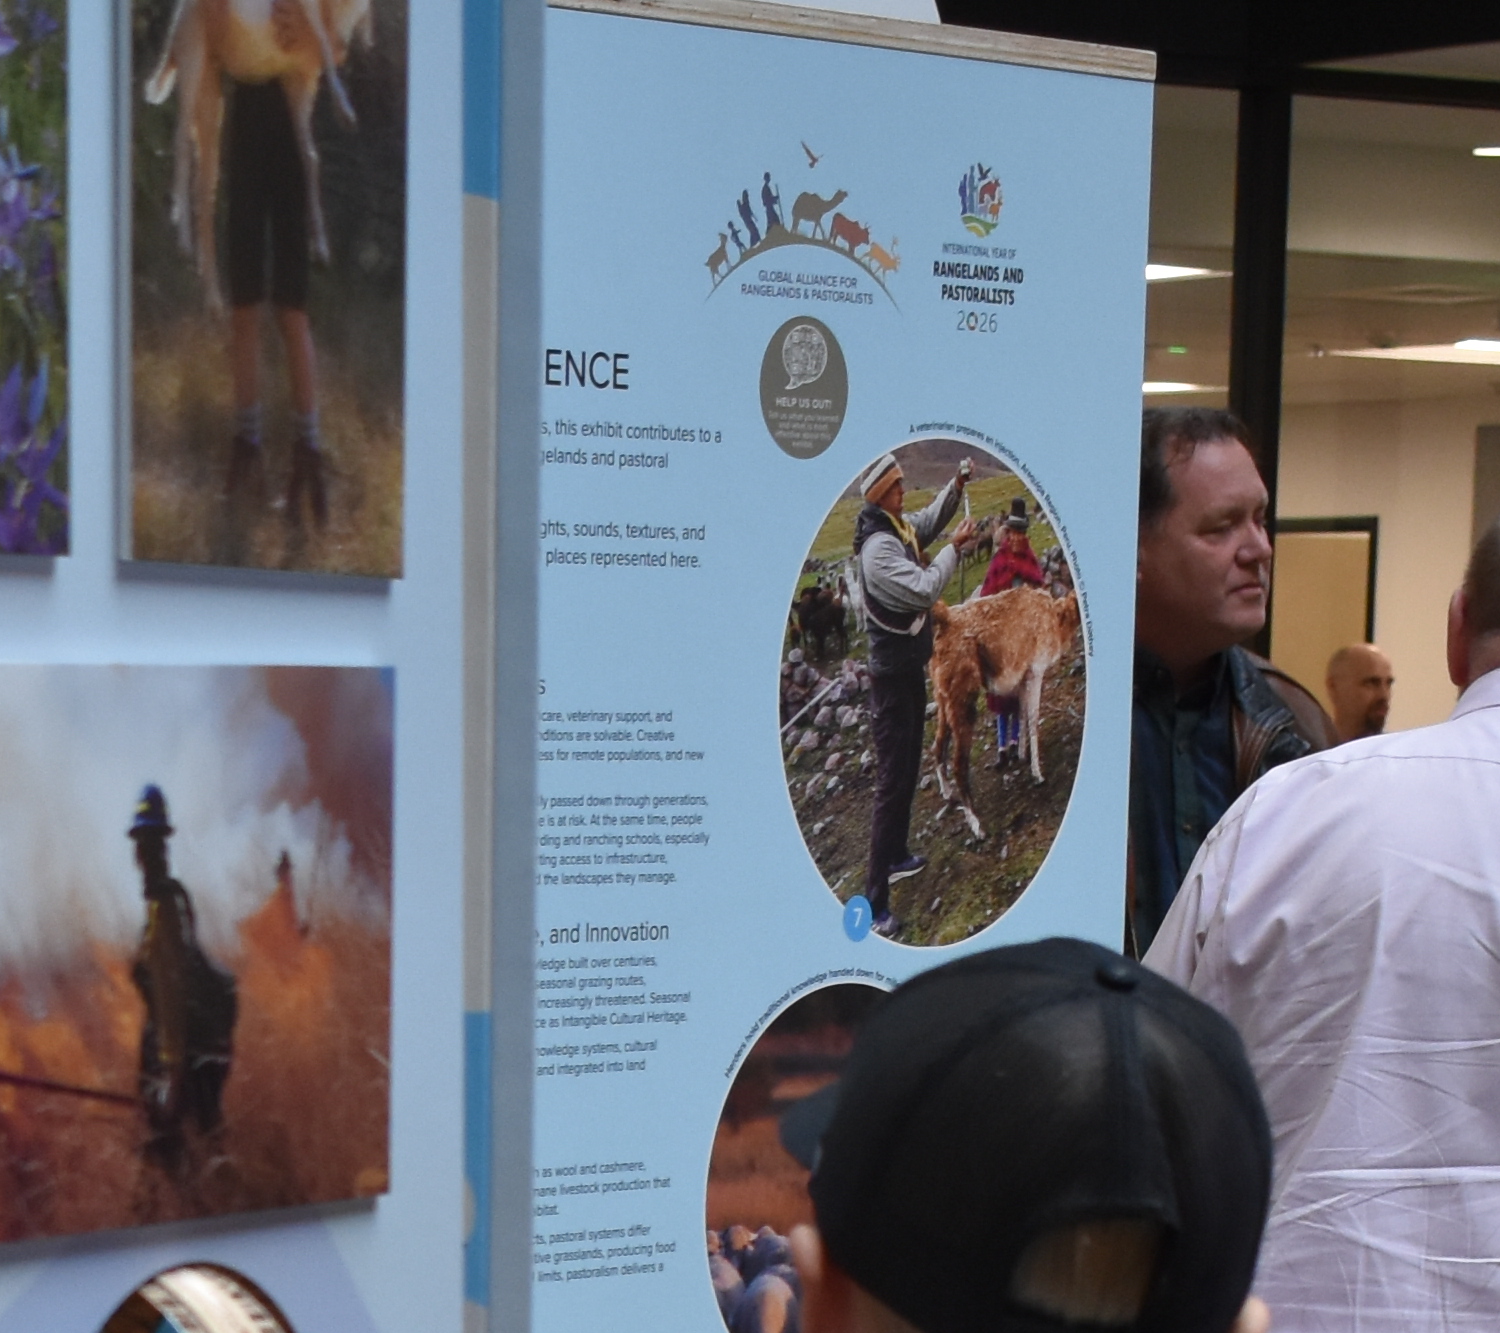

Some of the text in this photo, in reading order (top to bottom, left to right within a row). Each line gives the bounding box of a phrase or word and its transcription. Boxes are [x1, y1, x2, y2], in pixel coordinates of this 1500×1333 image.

[942, 243, 1016, 259] INTERNATIONAL YEAR OF
[758, 270, 857, 288] GLOBAL ALLIANCE FOR
[933, 261, 1023, 284] RANGELANDS AND
[741, 283, 873, 305] RANGELANDS & PASTORALISTS
[941, 284, 1014, 305] PASTORALISTS
[957, 310, 998, 333] 2026
[545, 348, 629, 390] ENCE
[776, 397, 832, 409] HELP US OUT!
[555, 418, 577, 435] this
[582, 421, 623, 438] exhibit
[626, 424, 695, 442] contributes
[700, 428, 711, 442] to
[715, 431, 722, 443] a
[909, 424, 914, 434] A
[591, 450, 668, 469] and pastoral
[573, 522, 705, 541] sounds, textures, and
[546, 548, 701, 568] places represented here.
[567, 710, 672, 724] veterinary support, and
[576, 731, 590, 741] are
[637, 729, 674, 741] Creative
[557, 749, 569, 761] for
[572, 750, 605, 761] remote
[665, 750, 683, 761] and
[685, 751, 703, 760] new
[551, 795, 584, 808] passed
[587, 795, 612, 807] down
[614, 795, 650, 809] through
[548, 815, 554, 826] is
[557, 816, 566, 826] at
[590, 814, 600, 825] At
[602, 814, 617, 825] the
[620, 816, 644, 825] same
[671, 814, 702, 826] people
[563, 834, 581, 846] and
[584, 833, 623, 847] ranching
[665, 832, 709, 846] especially
[559, 855, 591, 865] access
[594, 854, 602, 864] to
[544, 874, 558, 884] the
[562, 873, 614, 886] landscapes
[616, 872, 636, 885] they
[853, 908, 862, 928] 7
[550, 923, 580, 944] and
[586, 921, 669, 942] Innovation
[569, 957, 588, 969] built
[591, 959, 611, 968] over
[829, 967, 854, 979] handed
[855, 968, 874, 978] down
[578, 976, 612, 991] grazing
[650, 992, 691, 1004] Seasonal
[549, 1018, 559, 1028] as
[562, 1014, 607, 1029] Intangible
[610, 1012, 644, 1025] Cultural
[624, 1040, 657, 1052] cultural
[536, 1059, 646, 1077] and integrated into land
[542, 1168, 552, 1177] as
[555, 1165, 577, 1176] wool
[580, 1164, 597, 1175] and
[560, 1178, 670, 1195] livestock production that
[549, 1230, 586, 1244] pastoral
[588, 1228, 625, 1242] systems
[608, 1244, 653, 1259] producing
[655, 1242, 675, 1253] food
[621, 1263, 656, 1275] delivers
[658, 1263, 664, 1272] a
